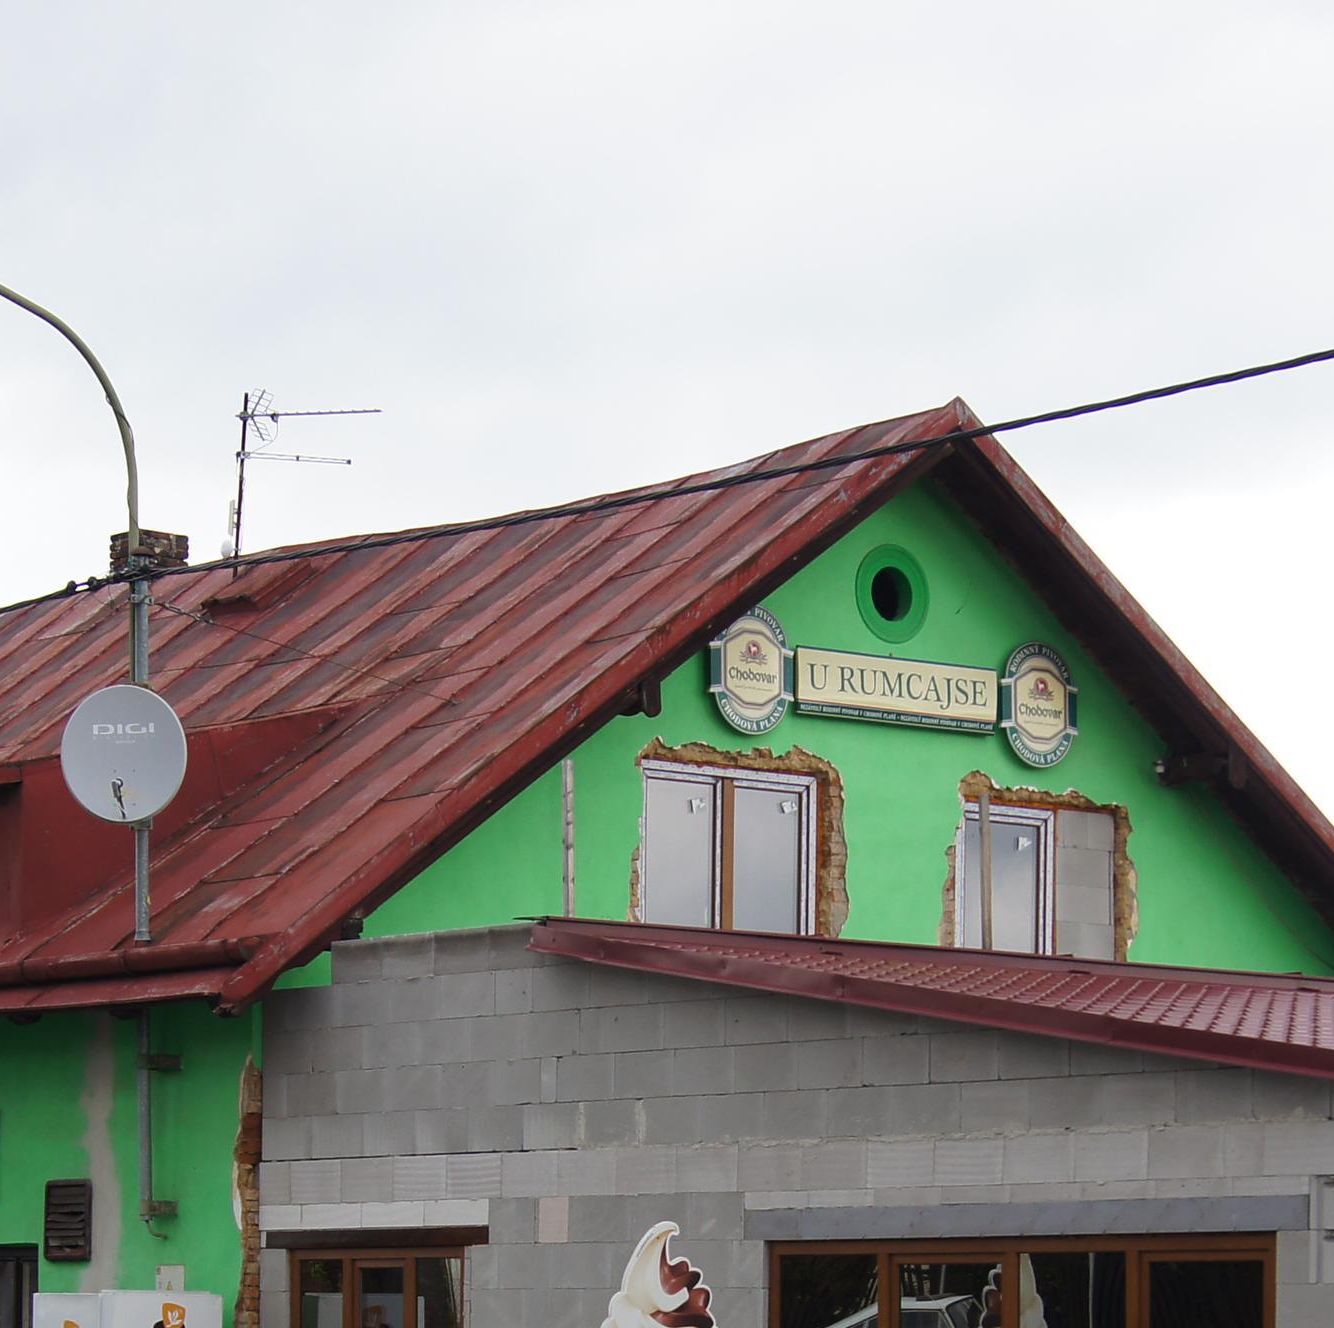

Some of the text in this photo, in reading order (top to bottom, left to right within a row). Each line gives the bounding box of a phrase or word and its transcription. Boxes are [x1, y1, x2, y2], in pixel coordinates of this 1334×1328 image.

[807, 662, 987, 711] U RUMCAJSE
[92, 723, 155, 735] DIGI
